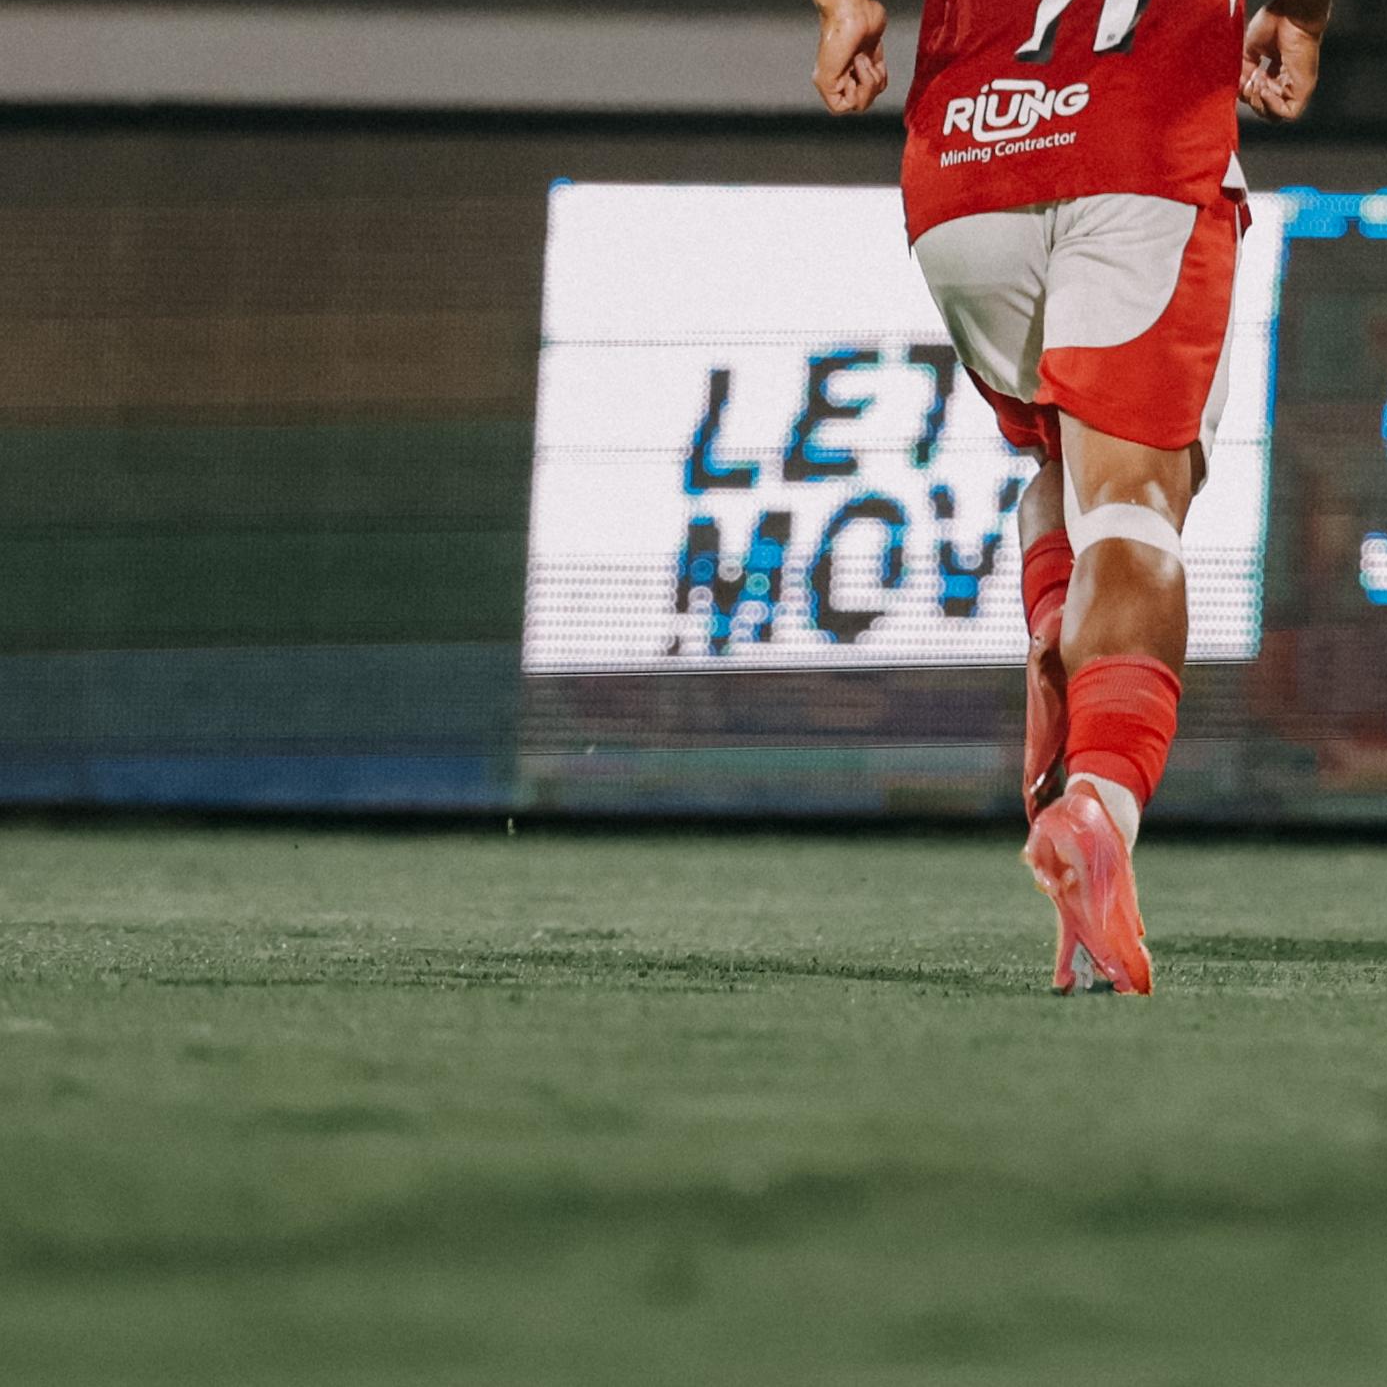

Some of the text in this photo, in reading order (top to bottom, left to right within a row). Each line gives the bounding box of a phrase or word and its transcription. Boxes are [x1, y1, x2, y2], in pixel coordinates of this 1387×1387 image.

[940, 131, 1077, 168] Mining Contractor
[683, 343, 960, 495] LET
[668, 490, 1026, 657] MOV
